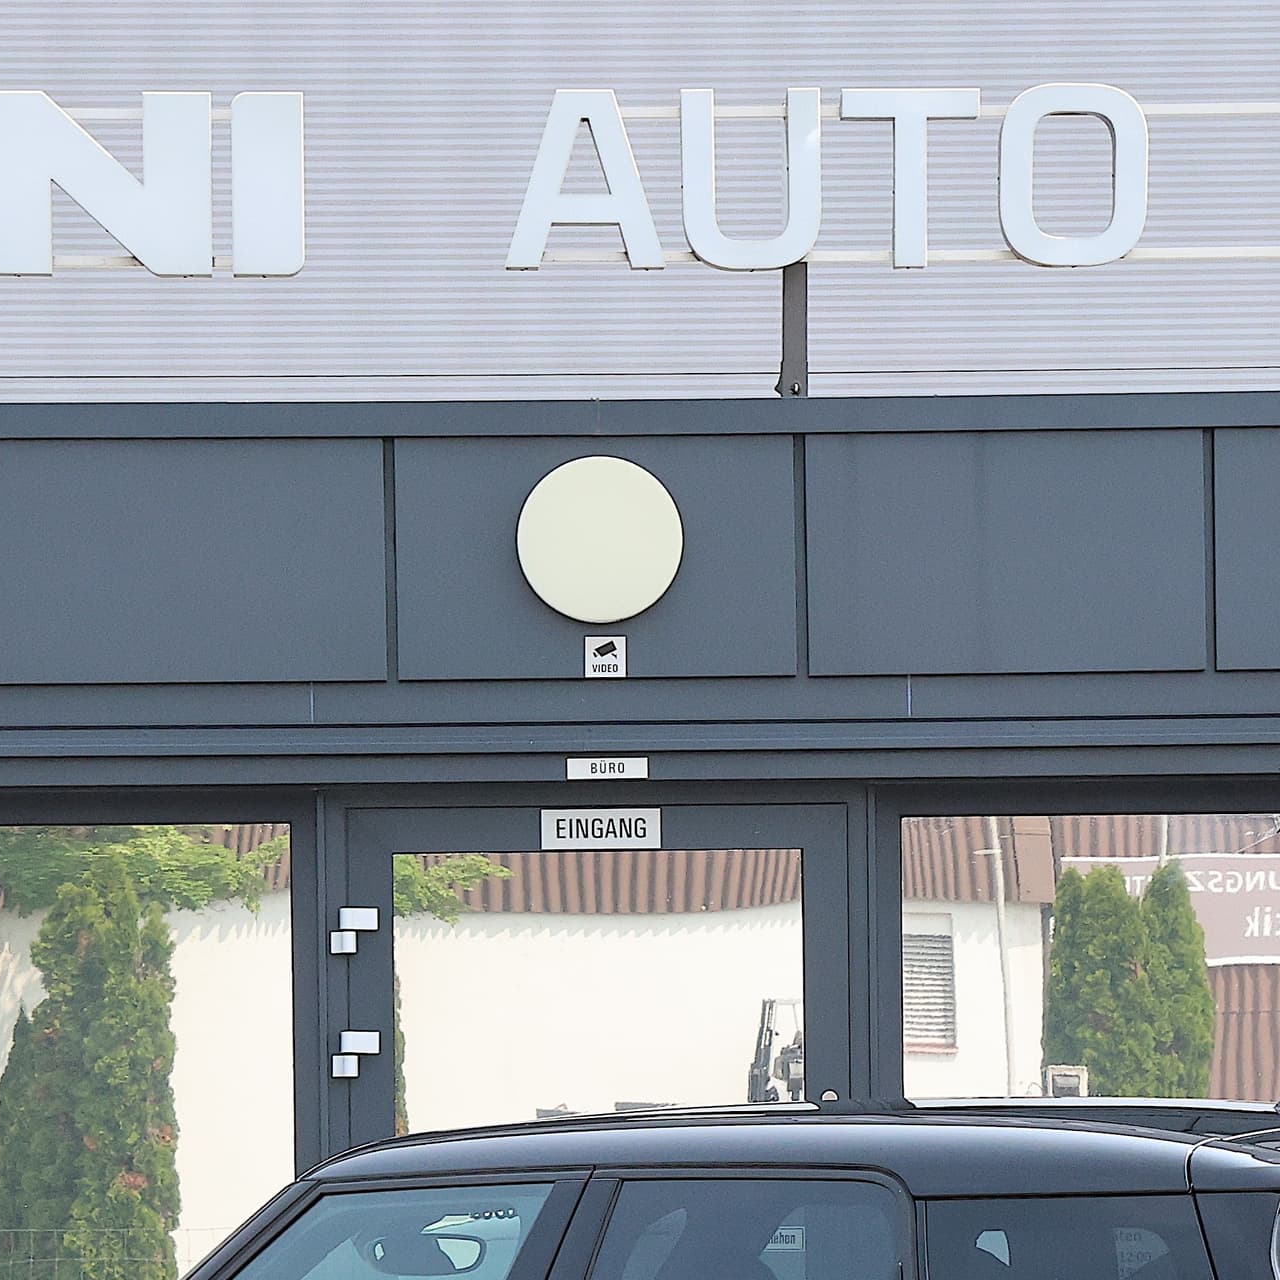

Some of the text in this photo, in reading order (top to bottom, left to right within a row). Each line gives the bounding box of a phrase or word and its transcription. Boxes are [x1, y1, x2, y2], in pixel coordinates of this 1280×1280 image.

[505, 82, 1150, 271] AUTO
[592, 663, 619, 673] VIDEO
[589, 760, 626, 775] BÜRO
[555, 817, 647, 840] EINGANG
